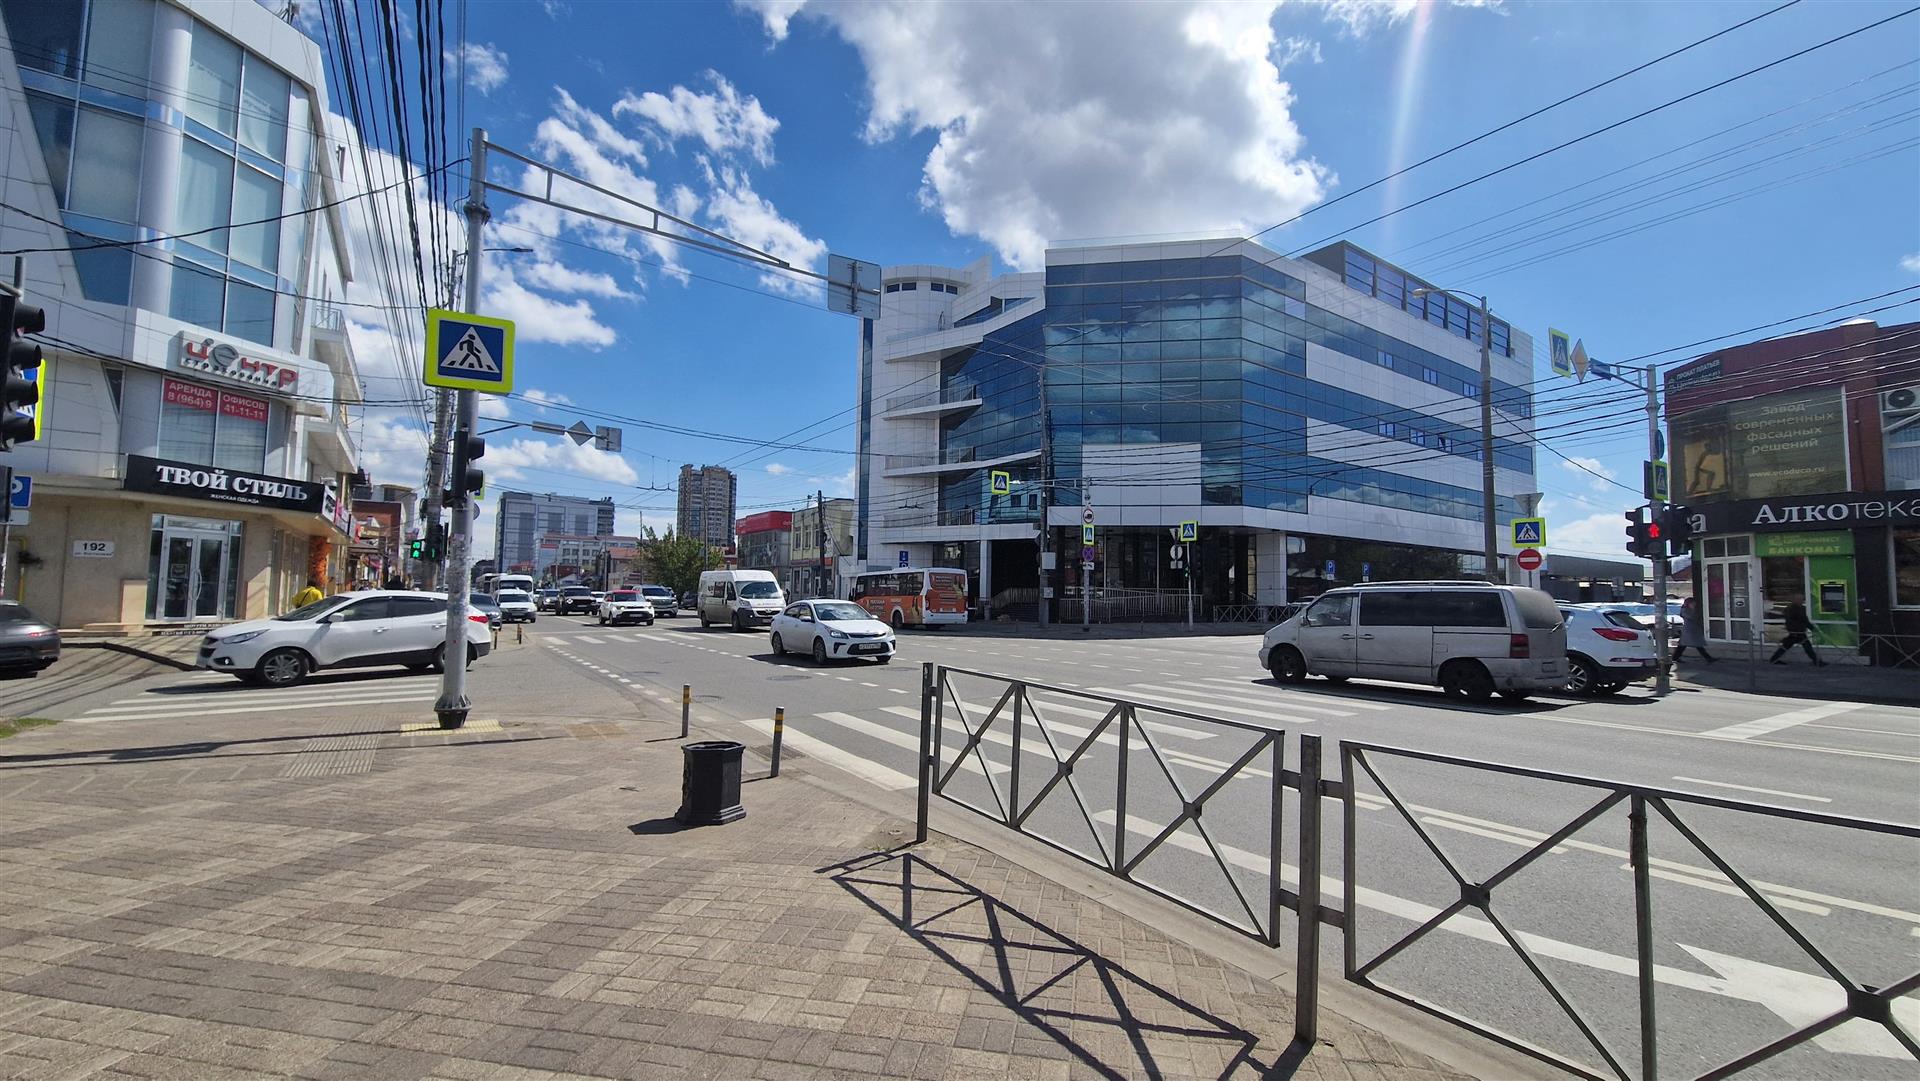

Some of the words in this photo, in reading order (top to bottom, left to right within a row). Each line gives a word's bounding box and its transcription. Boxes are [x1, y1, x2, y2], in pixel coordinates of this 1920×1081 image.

[169, 382, 212, 398] АРЕНДА
[222, 394, 265, 410] ОФИСОВ
[168, 391, 175, 401] 8
[224, 404, 264, 419] 41-11-11
[1760, 403, 1806, 415] Завод
[1735, 412, 1834, 431] современных
[1746, 426, 1822, 442] фасадных
[1751, 438, 1818, 455] решений
[156, 465, 228, 490] ТВОЙ
[232, 476, 308, 501] СТИЛЬ
[210, 493, 236, 502] ЖЕНСКАЯ
[237, 496, 259, 504] ОДЕЖДА
[83, 542, 106, 552] 192
[1768, 545, 1841, 555] БАНКОМАТ
